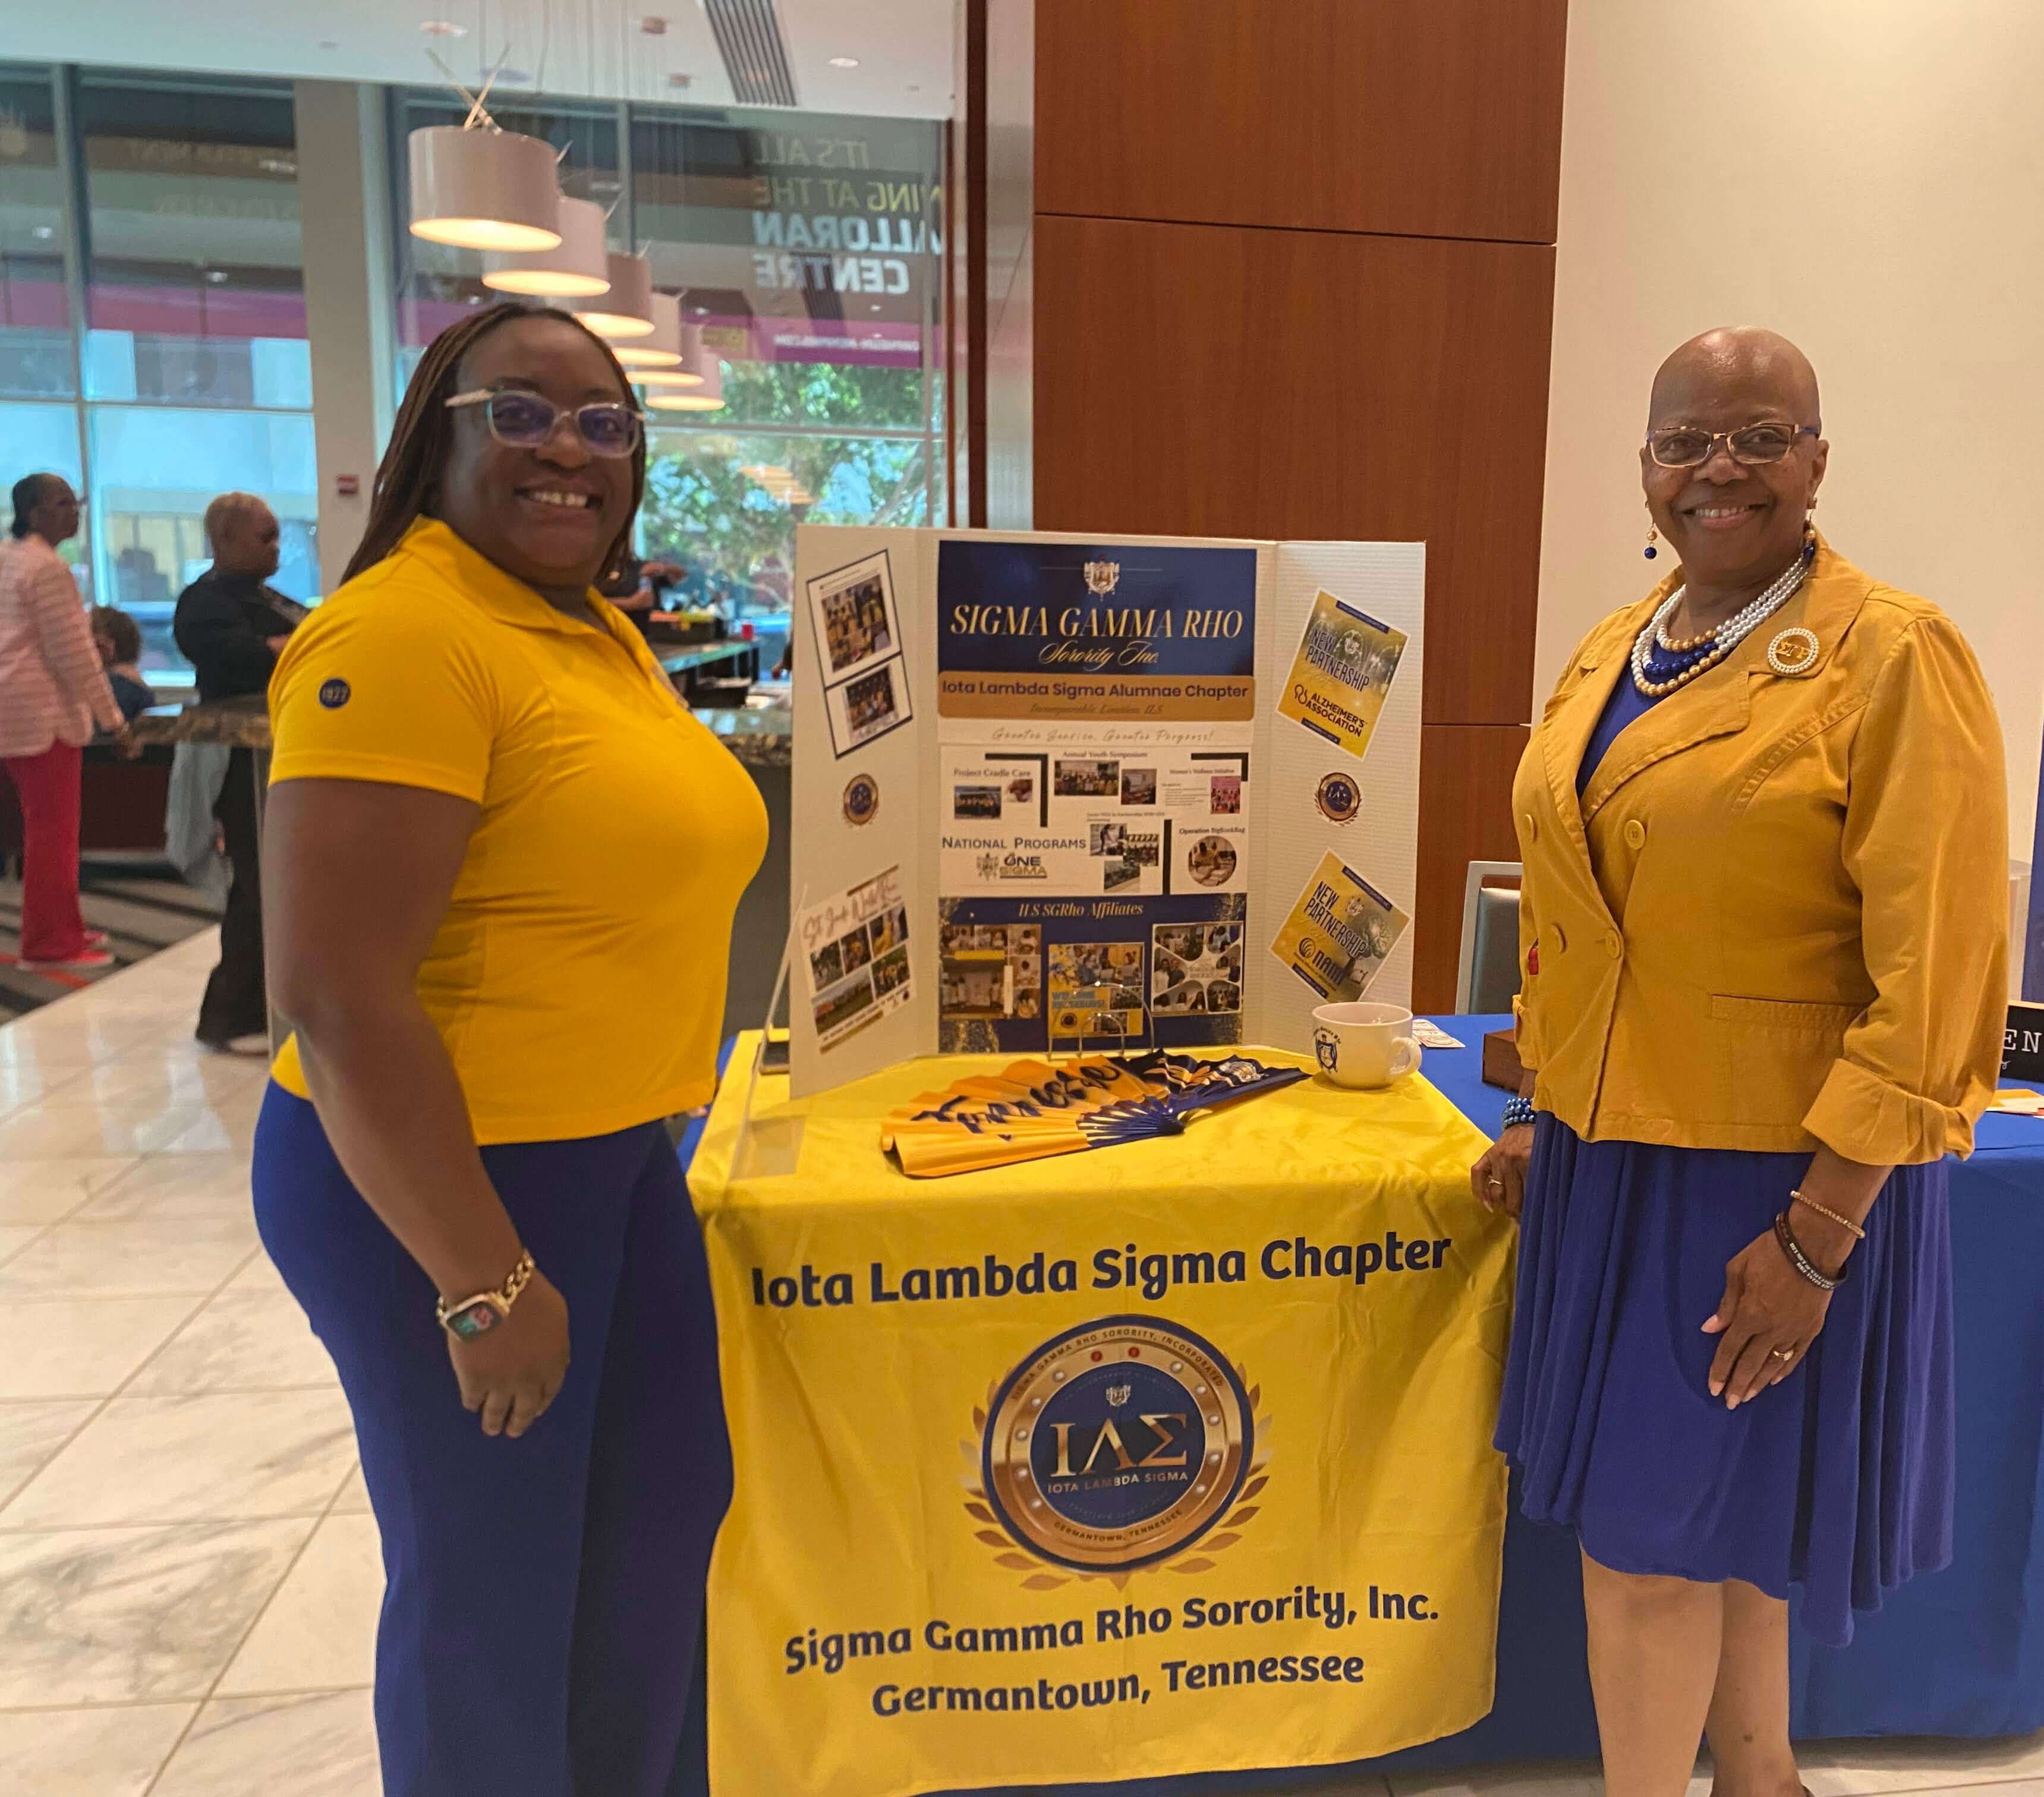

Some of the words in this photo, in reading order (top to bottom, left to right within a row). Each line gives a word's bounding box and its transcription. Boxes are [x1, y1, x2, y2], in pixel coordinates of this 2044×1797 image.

[950, 604, 1048, 637] SIGMA
[1060, 607, 1172, 638] GAMMA
[1182, 610, 1243, 639] RHO
[1311, 628, 1338, 652] NEW
[1038, 640, 1114, 672] Sorority
[1305, 645, 1370, 692] PARTNERSHIP
[942, 680, 975, 695] Iota
[980, 681, 1048, 696] Lambda
[1053, 683, 1105, 699] Sigma
[1109, 684, 1181, 698] Alumnae
[1185, 685, 1248, 701] Chapter
[1305, 701, 1362, 737] ASSOCIATION
[1310, 693, 1366, 729] ALZHEIMER'S
[954, 767, 981, 777] Project
[984, 768, 1010, 777] Cradle
[999, 866, 1047, 876] SIGMA
[1004, 854, 1041, 866] ONE
[1042, 903, 1085, 917] SGRho
[1312, 881, 1340, 910] NEW
[1303, 897, 1368, 957] PARTNERSHIP
[2002, 1029, 2043, 1054] EN
[751, 1266, 853, 1307] Iota
[871, 1253, 1078, 1301] Lambda
[1093, 1243, 1247, 1300] Sigma
[1261, 1231, 1453, 1285] Chapter
[1037, 1344, 1072, 1370] GAMMA
[1076, 1334, 1098, 1346] RHO
[1102, 1328, 1157, 1341] SORORITY,
[1161, 1336, 1223, 1387] INCORPORATED
[1047, 1483, 1079, 1493] IOTA
[1084, 1474, 1139, 1490] LAMBDA
[1144, 1471, 1188, 1483] SIGMA
[1129, 1509, 1183, 1537] TENNESSEE
[786, 1626, 912, 1675] Sigma
[925, 1618, 1084, 1653] Gamma
[1096, 1604, 1173, 1644] Rho
[1183, 1585, 1358, 1629] Sorority,
[1368, 1585, 1441, 1622] Inc.
[872, 1669, 1150, 1717] Germantown,
[1161, 1654, 1365, 1693] Tennessee
